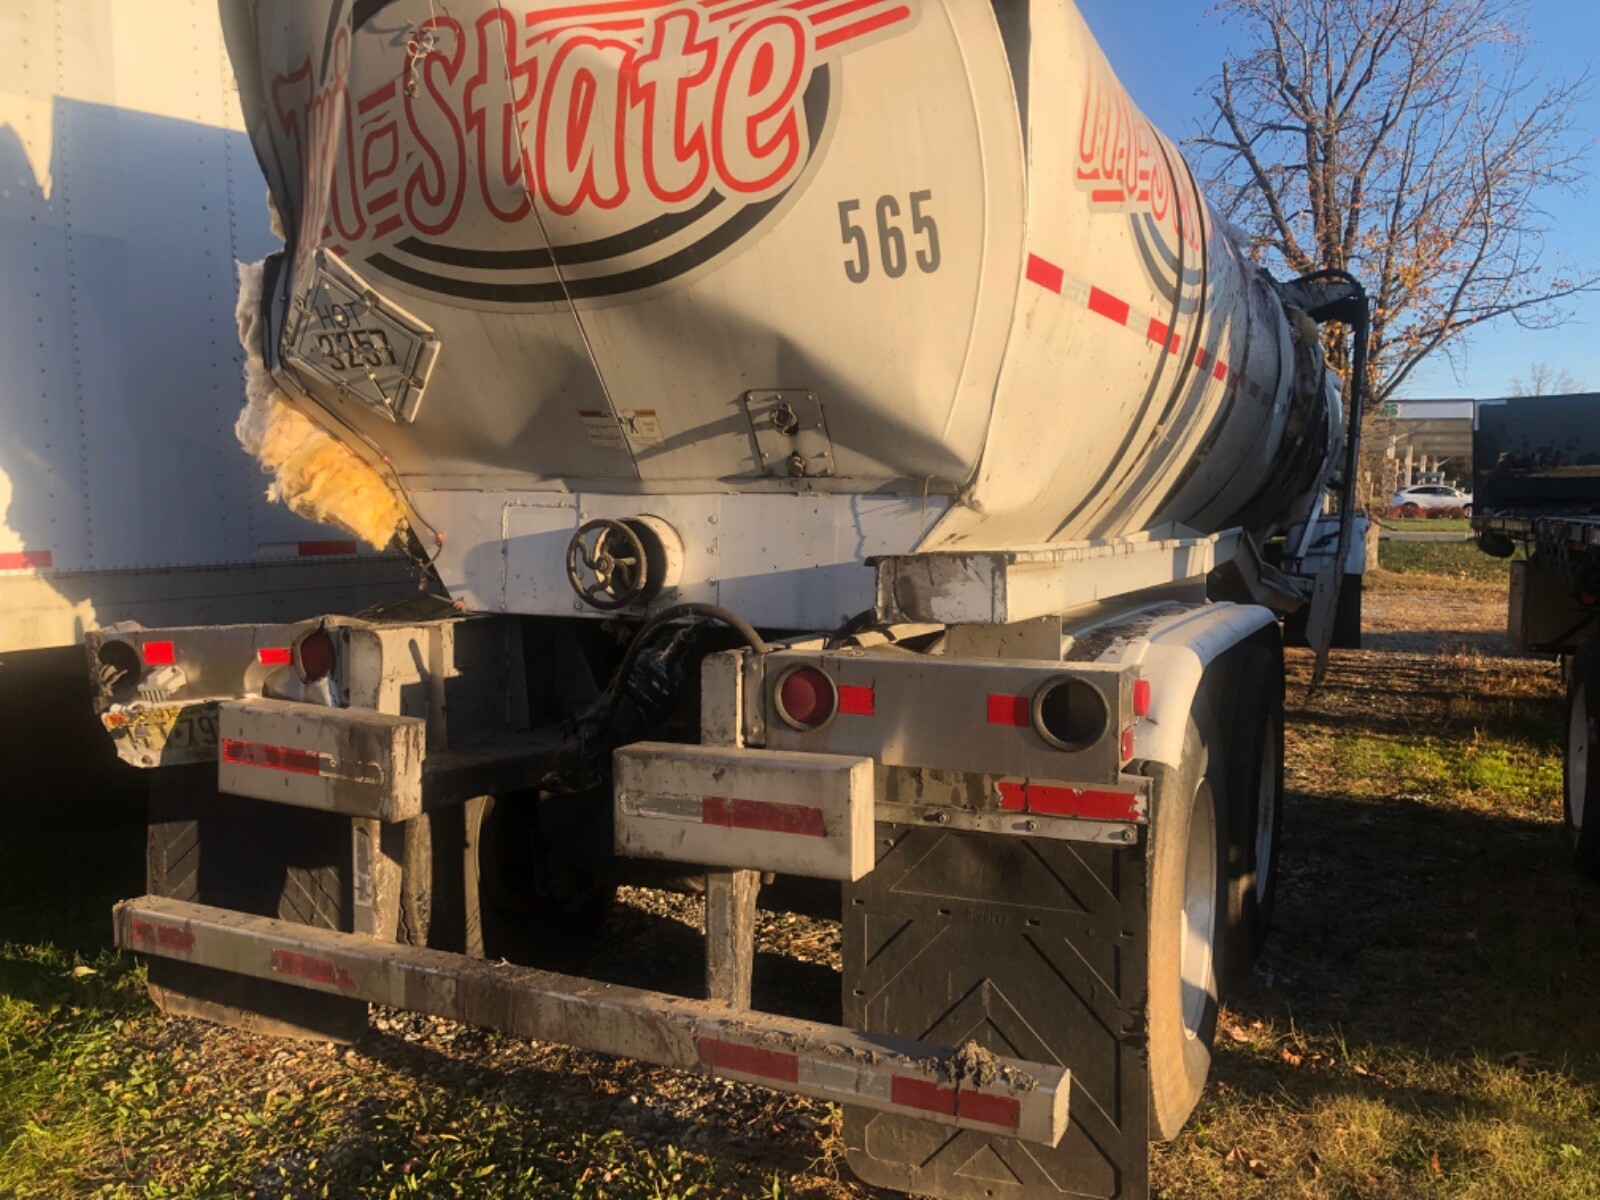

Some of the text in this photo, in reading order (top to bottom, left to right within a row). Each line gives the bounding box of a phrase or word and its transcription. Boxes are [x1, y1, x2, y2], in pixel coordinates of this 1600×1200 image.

[838, 189, 940, 283] 565
[316, 302, 361, 330] HOT
[317, 329, 396, 371] 3257
